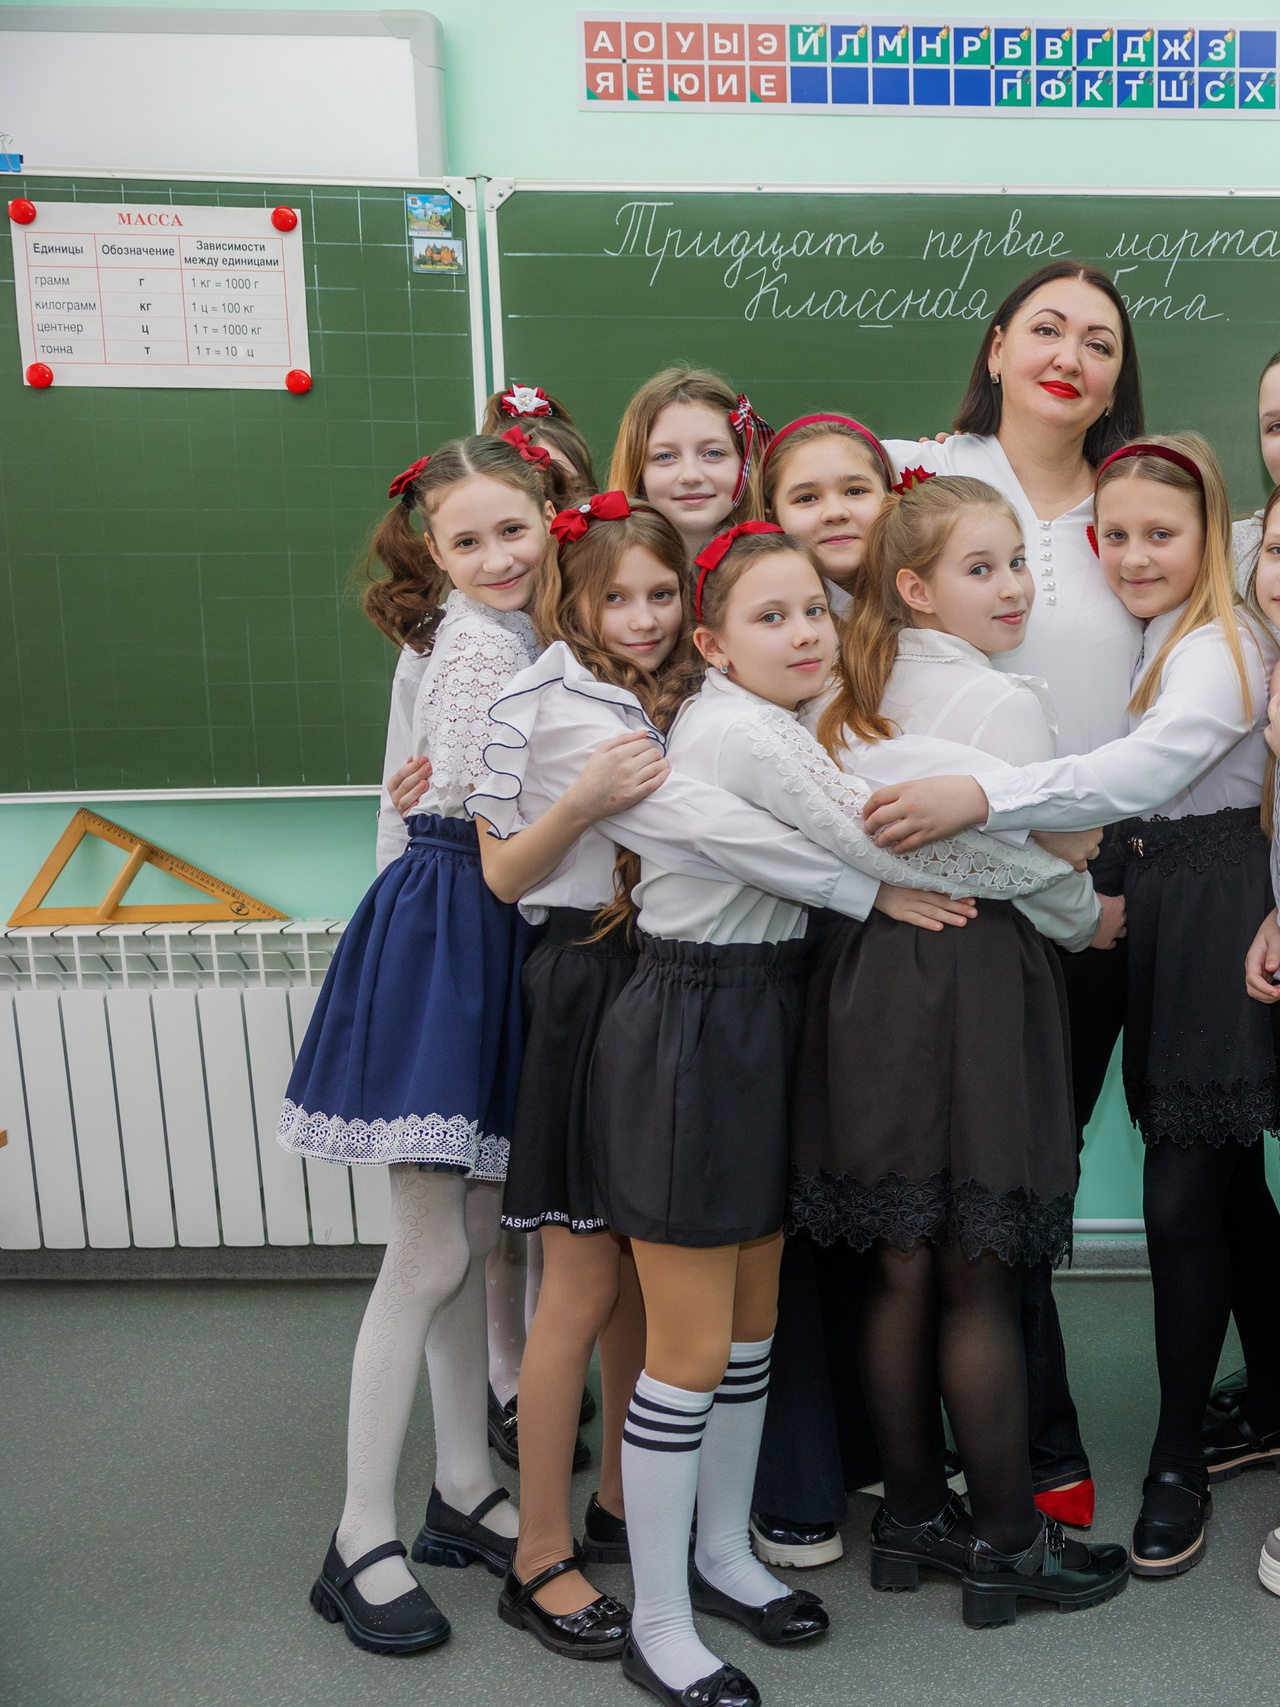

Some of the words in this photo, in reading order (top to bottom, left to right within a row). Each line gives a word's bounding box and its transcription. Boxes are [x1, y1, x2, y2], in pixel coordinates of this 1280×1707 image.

[593, 31, 614, 53] А
[634, 31, 655, 53] О
[676, 32, 694, 54] У
[715, 33, 739, 54] Ы
[757, 33, 777, 54] Э
[798, 27, 818, 56] Й
[838, 34, 859, 57] Л
[878, 35, 902, 57] М
[921, 36, 941, 58] Н
[963, 37, 981, 58] Р
[1004, 38, 1023, 58] Б
[1046, 38, 1063, 59] В
[1087, 39, 1102, 60] Г
[1123, 39, 1146, 61] Д
[1162, 39, 1191, 61] Ж
[1208, 40, 1226, 61] З
[595, 73, 615, 94] Я
[637, 67, 653, 95] Ё
[673, 74, 700, 95] Ю
[717, 74, 737, 95] И
[760, 75, 776, 96] Е
[1003, 79, 1022, 99] П
[1040, 78, 1067, 101] Ф
[1086, 80, 1103, 101] К
[1125, 80, 1143, 101] Т
[1160, 80, 1188, 101] Ш
[1205, 80, 1225, 102] С
[1245, 81, 1265, 102] Х
[117, 212, 184, 227] МАССА
[33, 243, 84, 256] Единицы
[101, 244, 175, 257] Обозначение
[196, 240, 266, 252] Зависимости
[603, 200, 885, 289] Тридцать
[922, 208, 1072, 290] первое
[184, 256, 219, 267] между
[221, 257, 280, 267] единицами
[34, 276, 70, 287] грамм
[139, 278, 145, 287] г
[191, 277, 196, 288] 1
[200, 279, 211, 288] кг
[225, 278, 251, 289] 1000
[745, 266, 994, 323] Классная
[35, 300, 97, 313] килограмм
[140, 302, 152, 312] кг
[192, 301, 197, 312] 1
[201, 304, 208, 314] ц
[222, 302, 241, 314] 100
[243, 305, 254, 313] кг
[37, 322, 84, 335] центнер
[141, 324, 150, 335] ц
[193, 323, 198, 334] 1
[202, 325, 209, 334] т
[222, 324, 248, 335] 1000
[251, 326, 262, 335] кг
[40, 344, 73, 355] тонна
[144, 346, 151, 355] т
[196, 345, 201, 356] 1
[205, 347, 211, 356] т
[225, 345, 238, 357] 10
[246, 348, 255, 358] ц
[572, 1217, 605, 1230] FASHI
